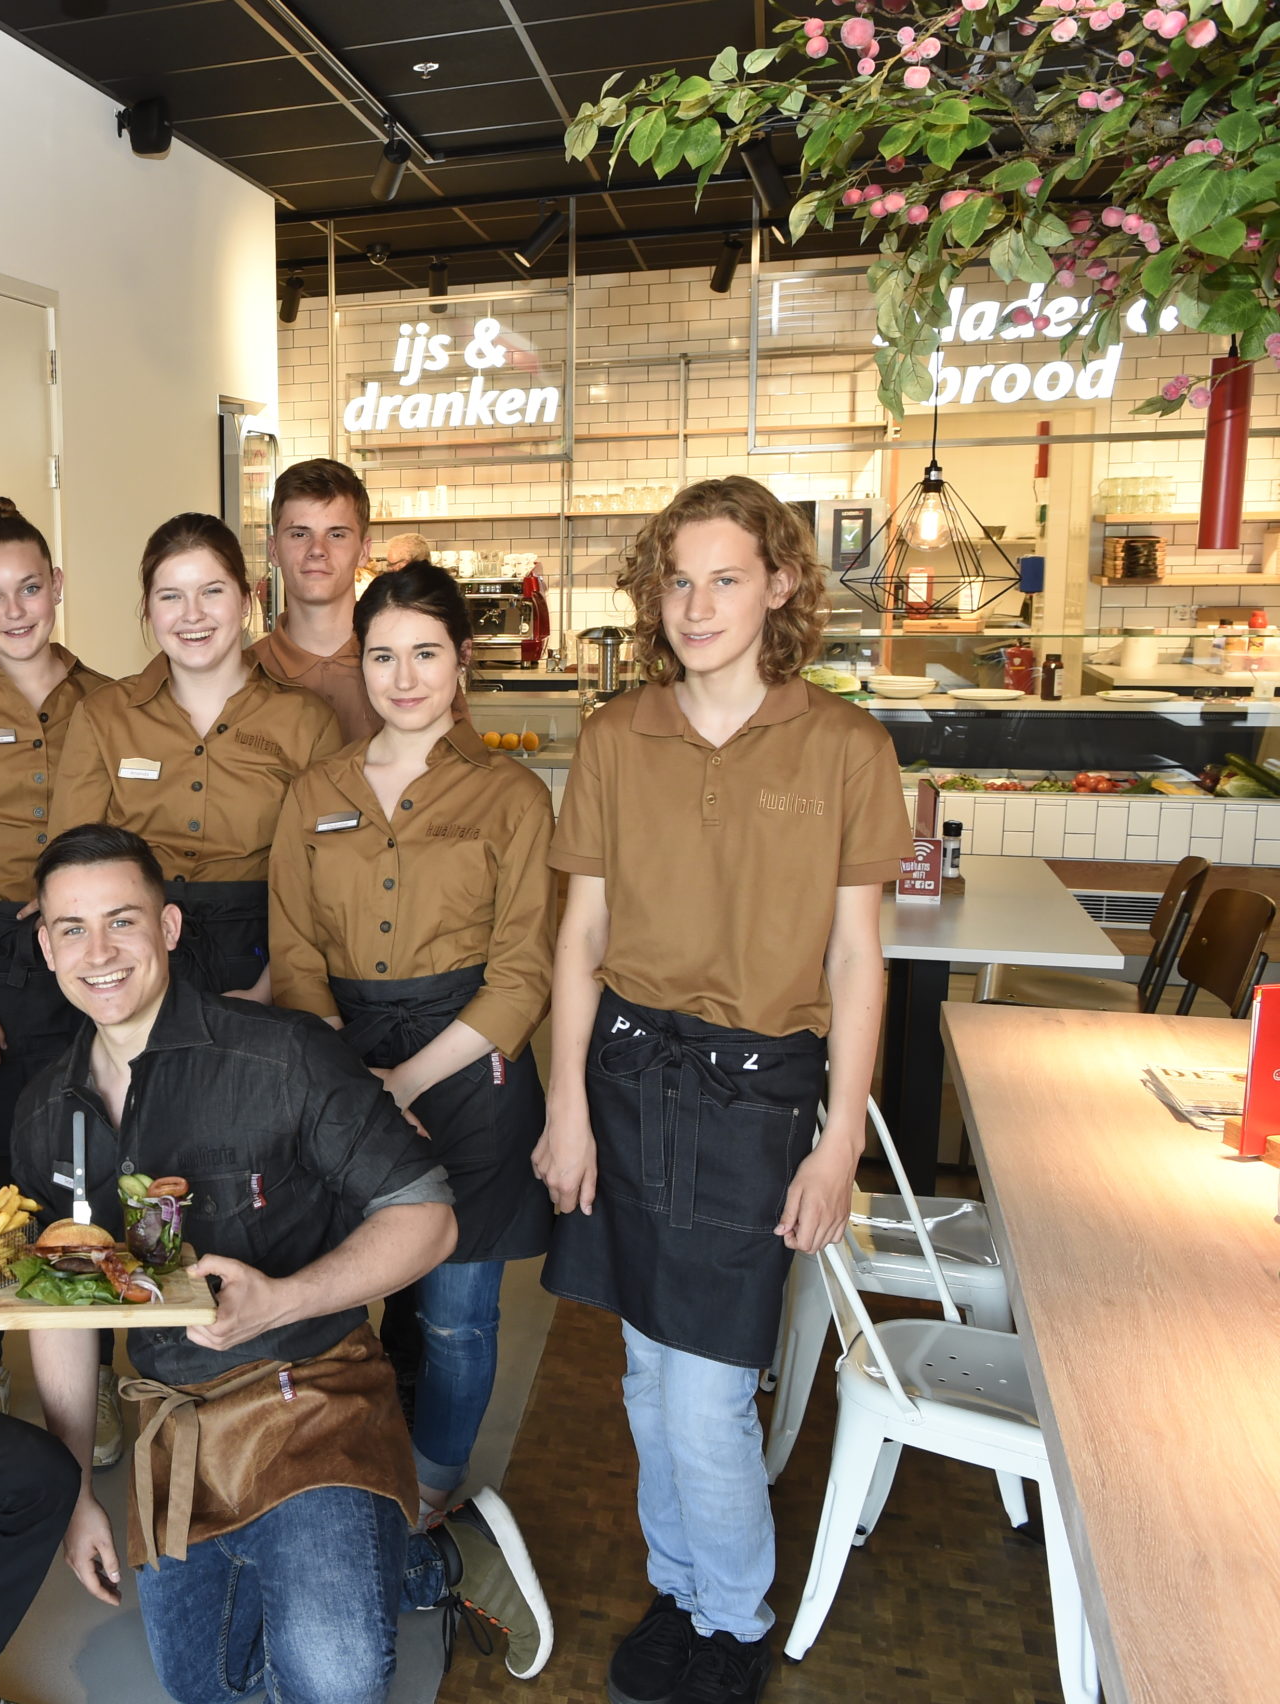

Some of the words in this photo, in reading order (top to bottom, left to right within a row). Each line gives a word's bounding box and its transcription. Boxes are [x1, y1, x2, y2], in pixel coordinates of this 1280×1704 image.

[394, 322, 452, 386] ijs
[464, 318, 507, 369] &
[920, 342, 1124, 406] brood
[344, 376, 559, 432] dranken
